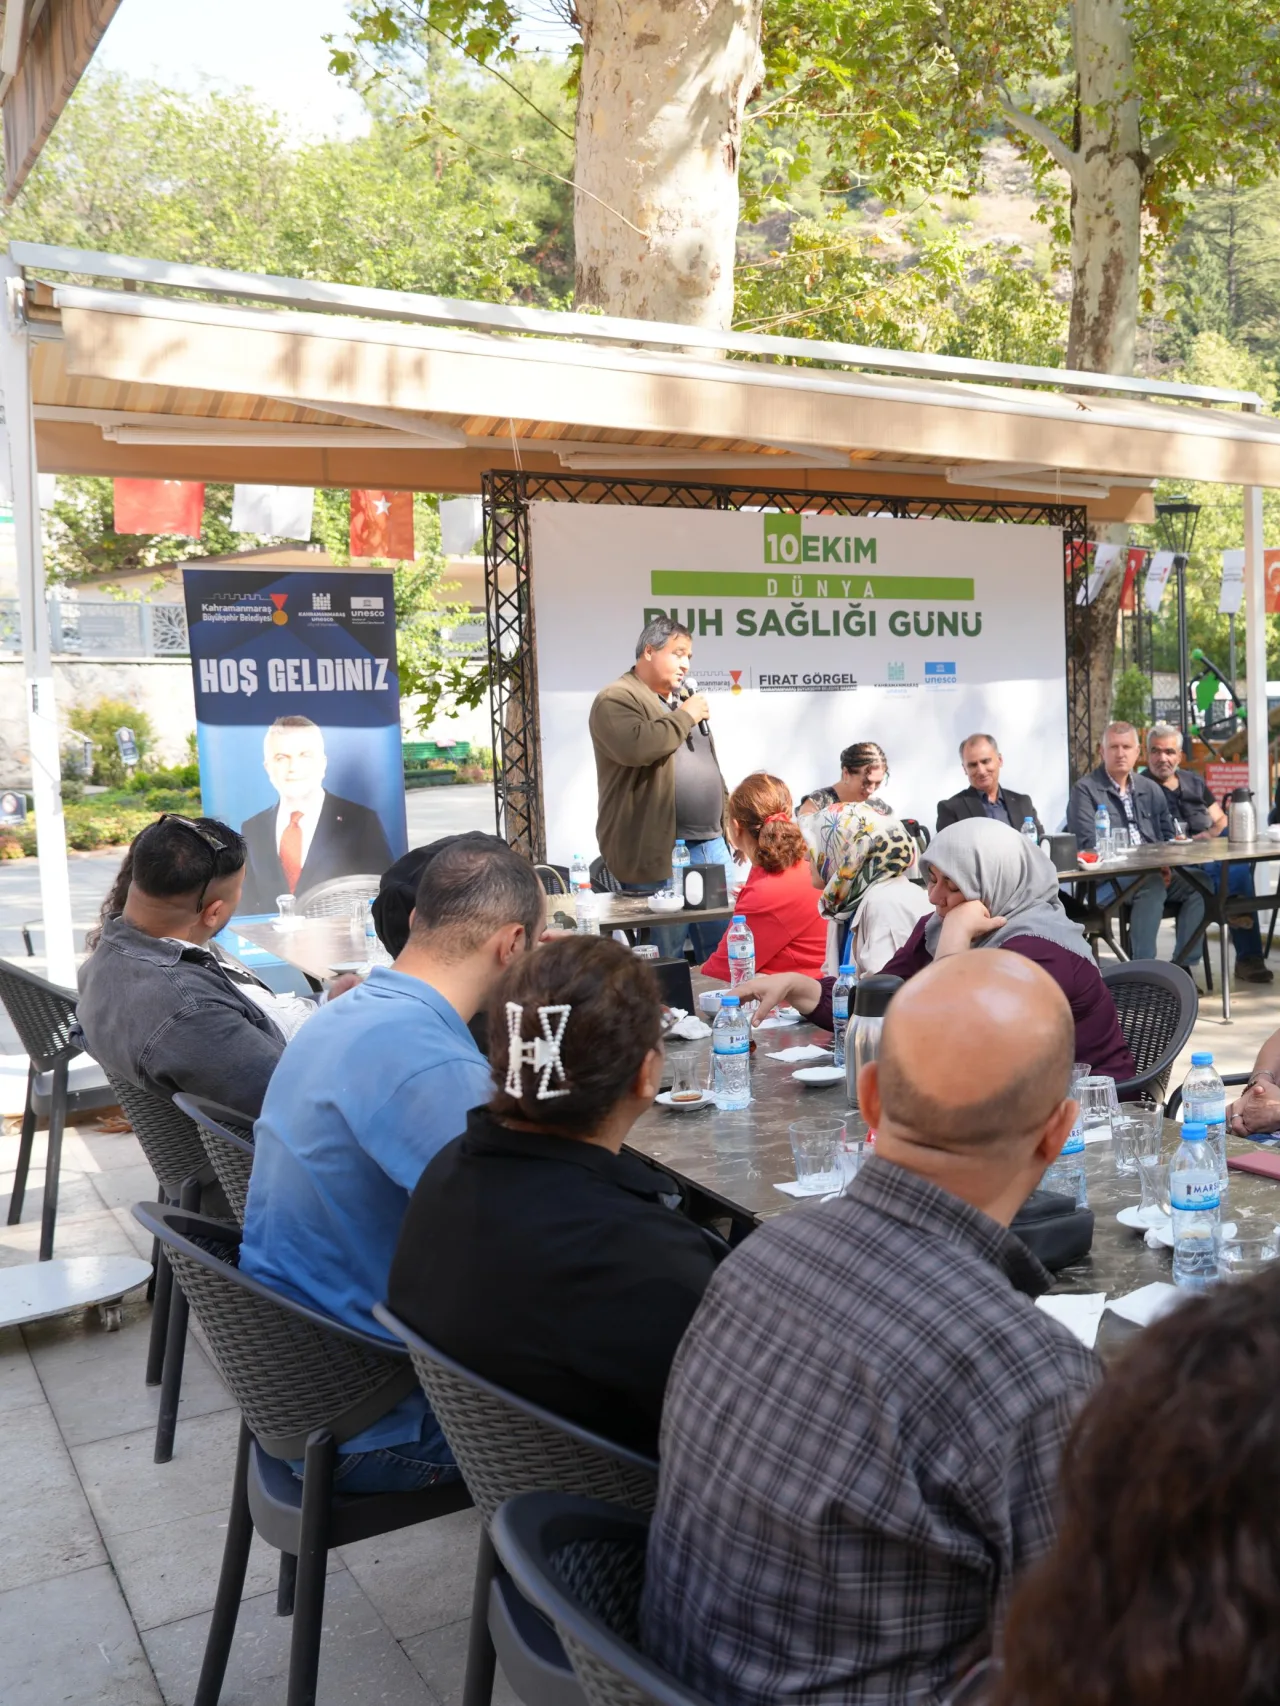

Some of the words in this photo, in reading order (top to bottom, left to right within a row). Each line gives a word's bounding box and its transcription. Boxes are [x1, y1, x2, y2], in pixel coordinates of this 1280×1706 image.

[767, 533, 799, 562] 10
[802, 535, 877, 564] EKİM
[767, 575, 875, 598] DÜNYA
[202, 603, 272, 614] Kahramanmaraş
[202, 612, 239, 623] Büyükşehir
[240, 613, 273, 623] Belediyesi
[735, 601, 877, 637] SAĞLIĞI
[888, 610, 983, 637] GÜNÜ
[199, 658, 258, 697] HOŞ
[267, 658, 389, 693] GELDİNİZ
[759, 674, 798, 686] FIRAT
[802, 672, 857, 685] GÖRGEL
[925, 676, 957, 684] unesco
